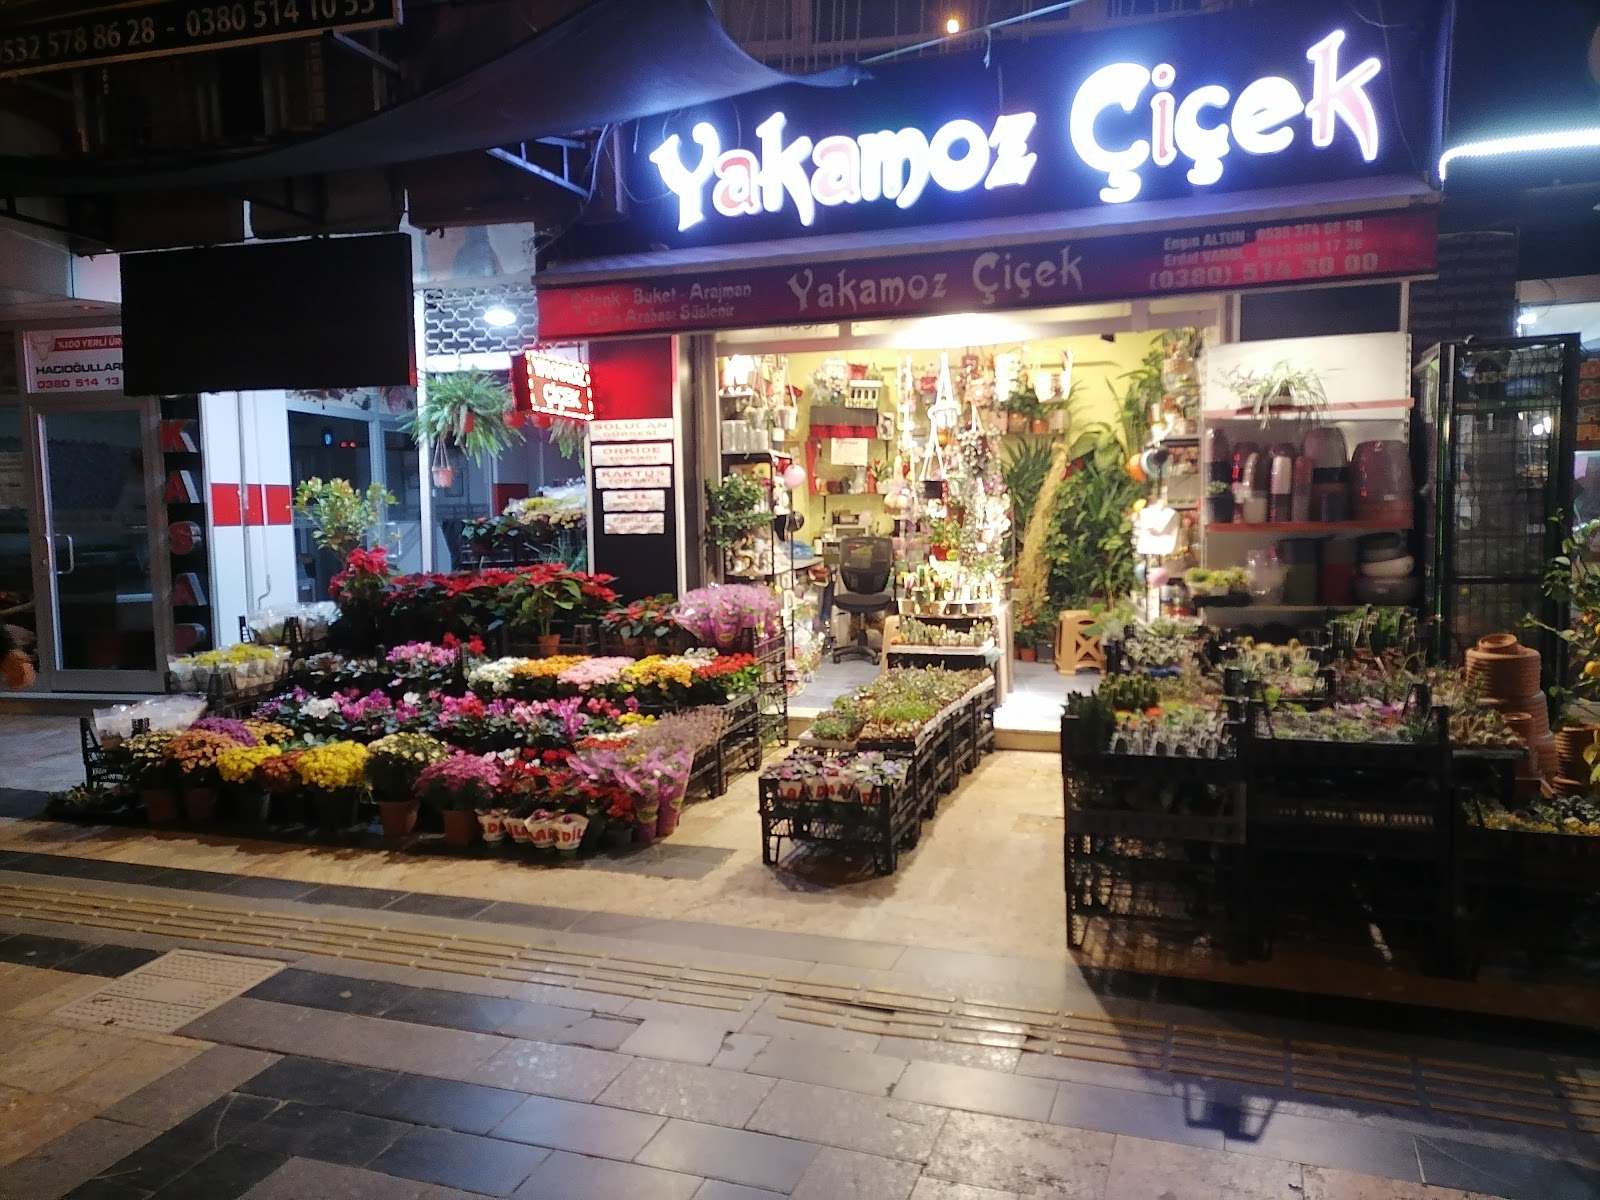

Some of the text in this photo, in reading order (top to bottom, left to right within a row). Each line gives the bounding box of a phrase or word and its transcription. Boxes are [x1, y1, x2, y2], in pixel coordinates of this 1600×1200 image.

[47, 26, 88, 56] 578
[93, 23, 122, 50] 86
[127, 17, 156, 46] 28
[185, 7, 247, 38] 0380
[253, 0, 300, 28] 514
[648, 29, 1382, 232] Yakamoz Çiçek
[1203, 230, 1246, 246] ALTUN
[787, 246, 1083, 312] Yakamoz Çiçek
[1149, 251, 1379, 290] (0380) 514 30 00
[632, 286, 677, 305] Buket
[689, 282, 753, 306] Arajman
[679, 302, 735, 321] Süslenir
[37, 376, 120, 389] 0380 514 13
[594, 422, 667, 431] SOLUCAN
[602, 447, 661, 455] ORKİDE
